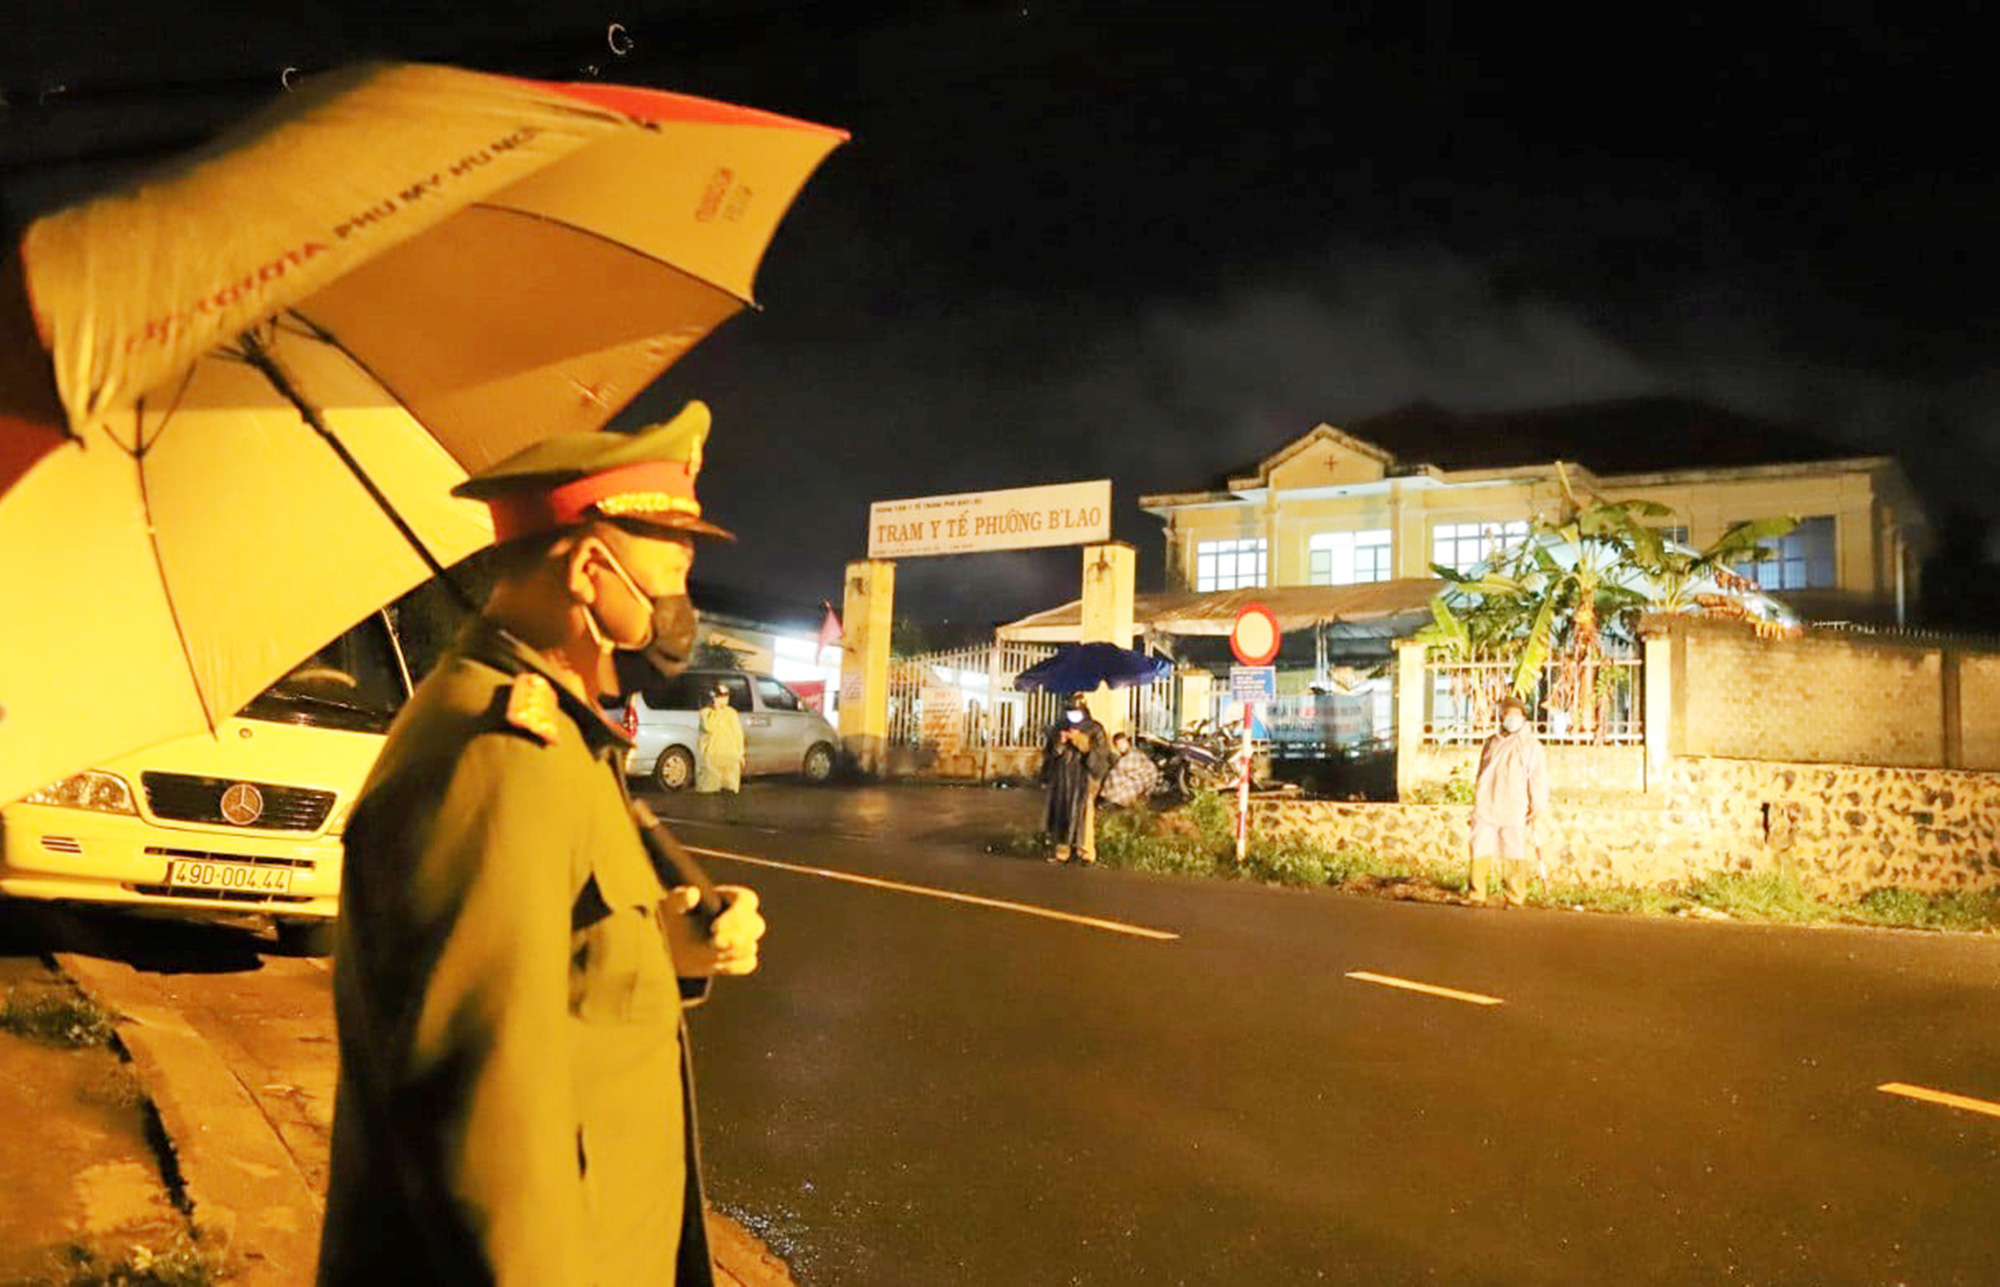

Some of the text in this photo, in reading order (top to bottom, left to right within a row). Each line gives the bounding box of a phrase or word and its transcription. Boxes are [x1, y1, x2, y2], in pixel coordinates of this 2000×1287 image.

[876, 521, 923, 547] TRẠM
[930, 520, 942, 539] Y
[946, 509, 970, 538] TẾ
